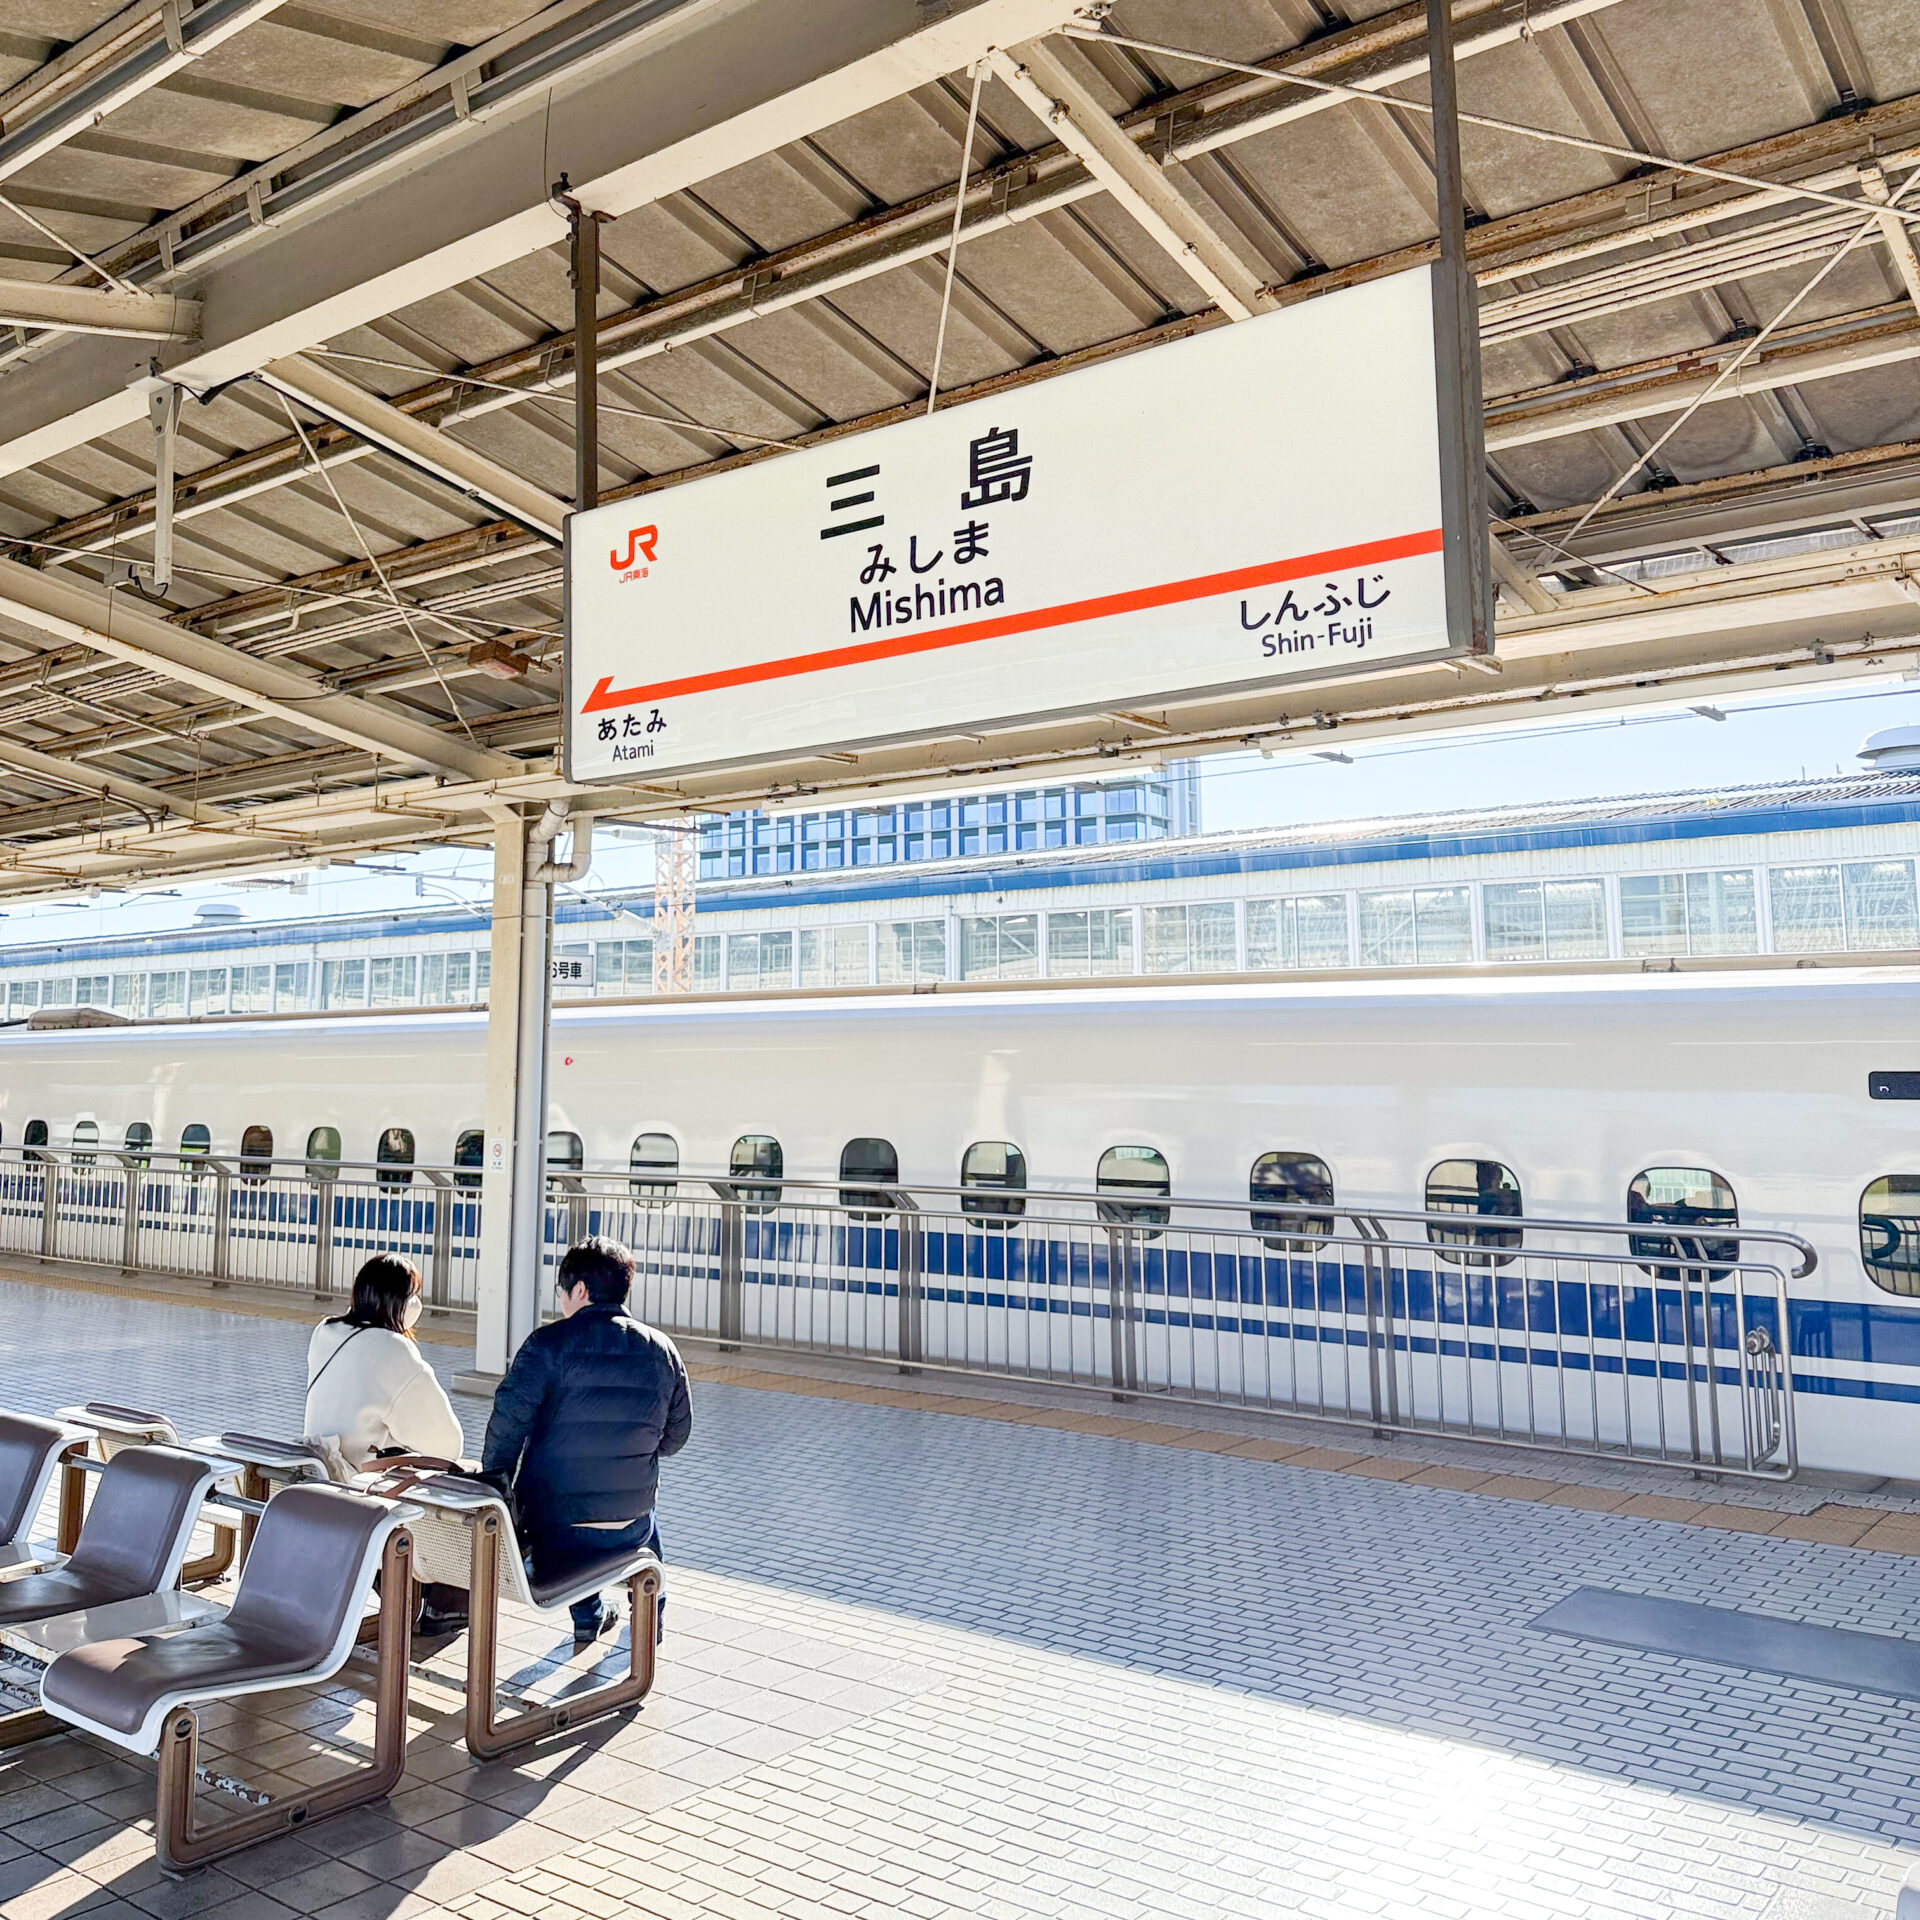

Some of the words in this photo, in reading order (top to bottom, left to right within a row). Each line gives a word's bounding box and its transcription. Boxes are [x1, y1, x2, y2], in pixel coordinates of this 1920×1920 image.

[821, 426, 1033, 540] 三島
[610, 524, 658, 571] JR
[859, 520, 990, 585] みしま
[850, 577, 1005, 633] Mishima
[1240, 574, 1391, 631] しんふじ
[1261, 616, 1373, 658] Shin-Fuji
[597, 708, 667, 742] あたみ
[612, 739, 655, 762] Atami
